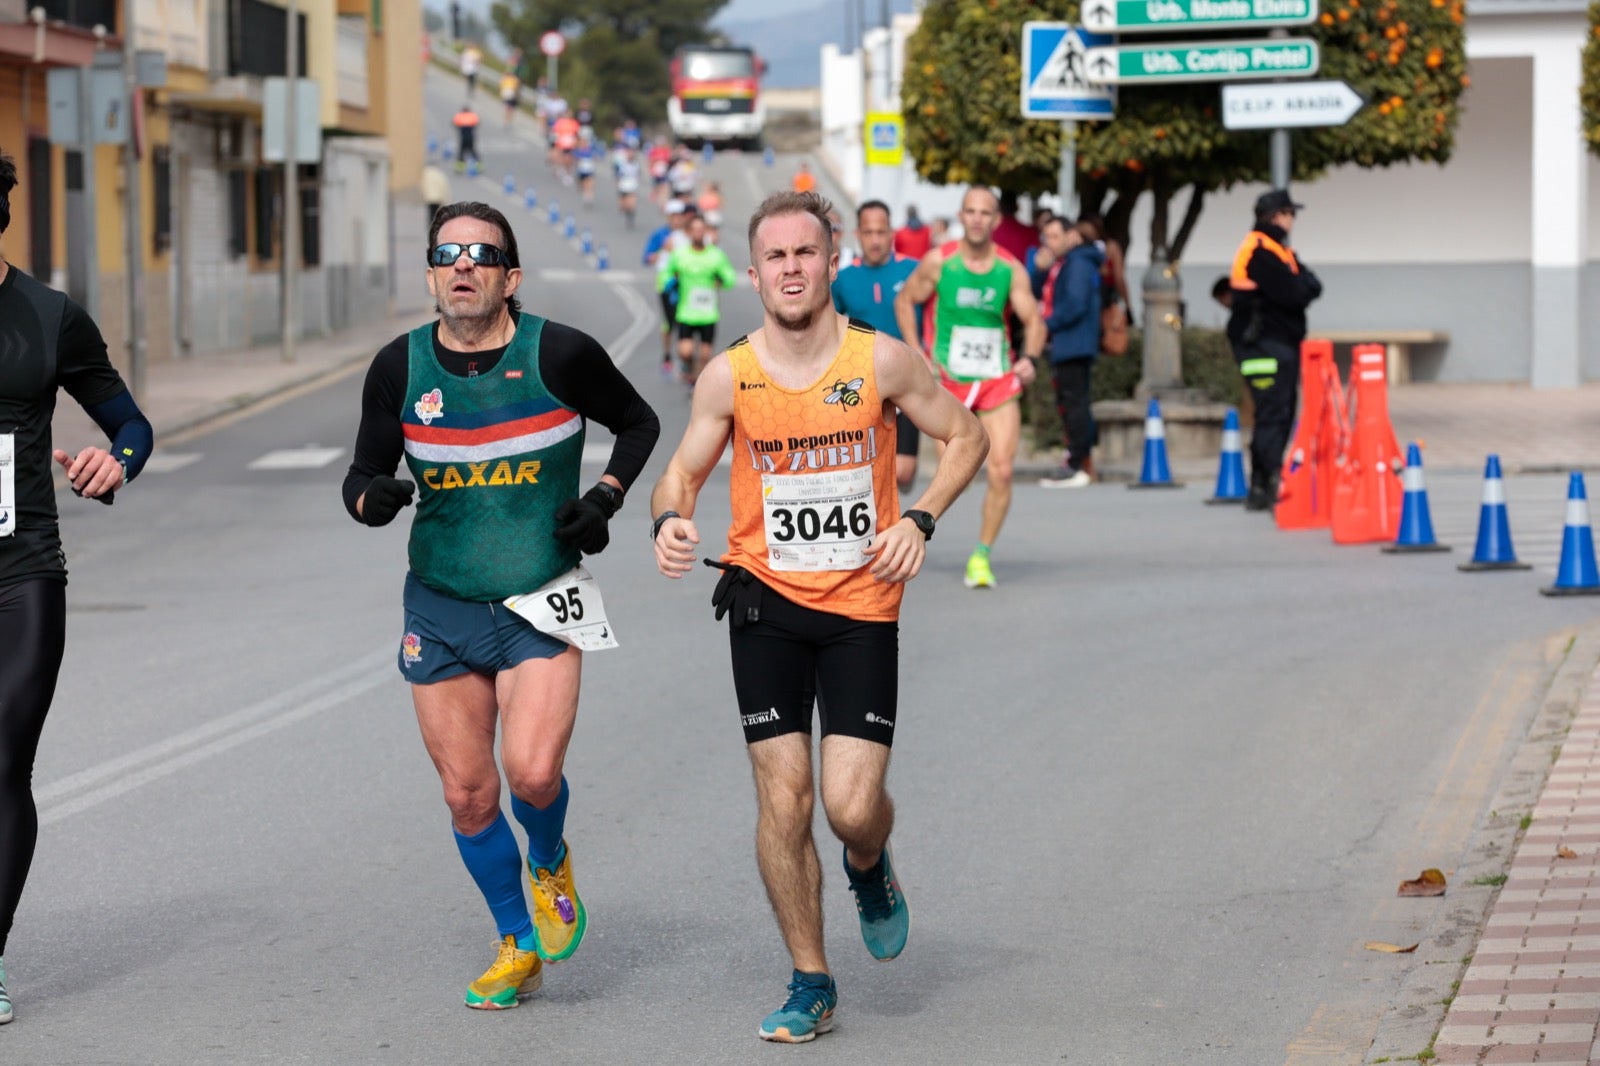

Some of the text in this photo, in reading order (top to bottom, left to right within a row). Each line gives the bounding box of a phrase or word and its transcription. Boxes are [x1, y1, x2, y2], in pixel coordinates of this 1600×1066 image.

[1147, 0, 1306, 21] Urb. Monte Elvira
[1143, 46, 1308, 73] Urb. Cortijo Pretel
[961, 341, 993, 360] 252
[753, 430, 864, 453] Club Deportivo
[788, 426, 878, 472] ZUBIA
[422, 459, 542, 491] CAXAR
[771, 501, 871, 543] 3046
[546, 586, 584, 624] 95
[748, 707, 781, 726] ZUBIA
